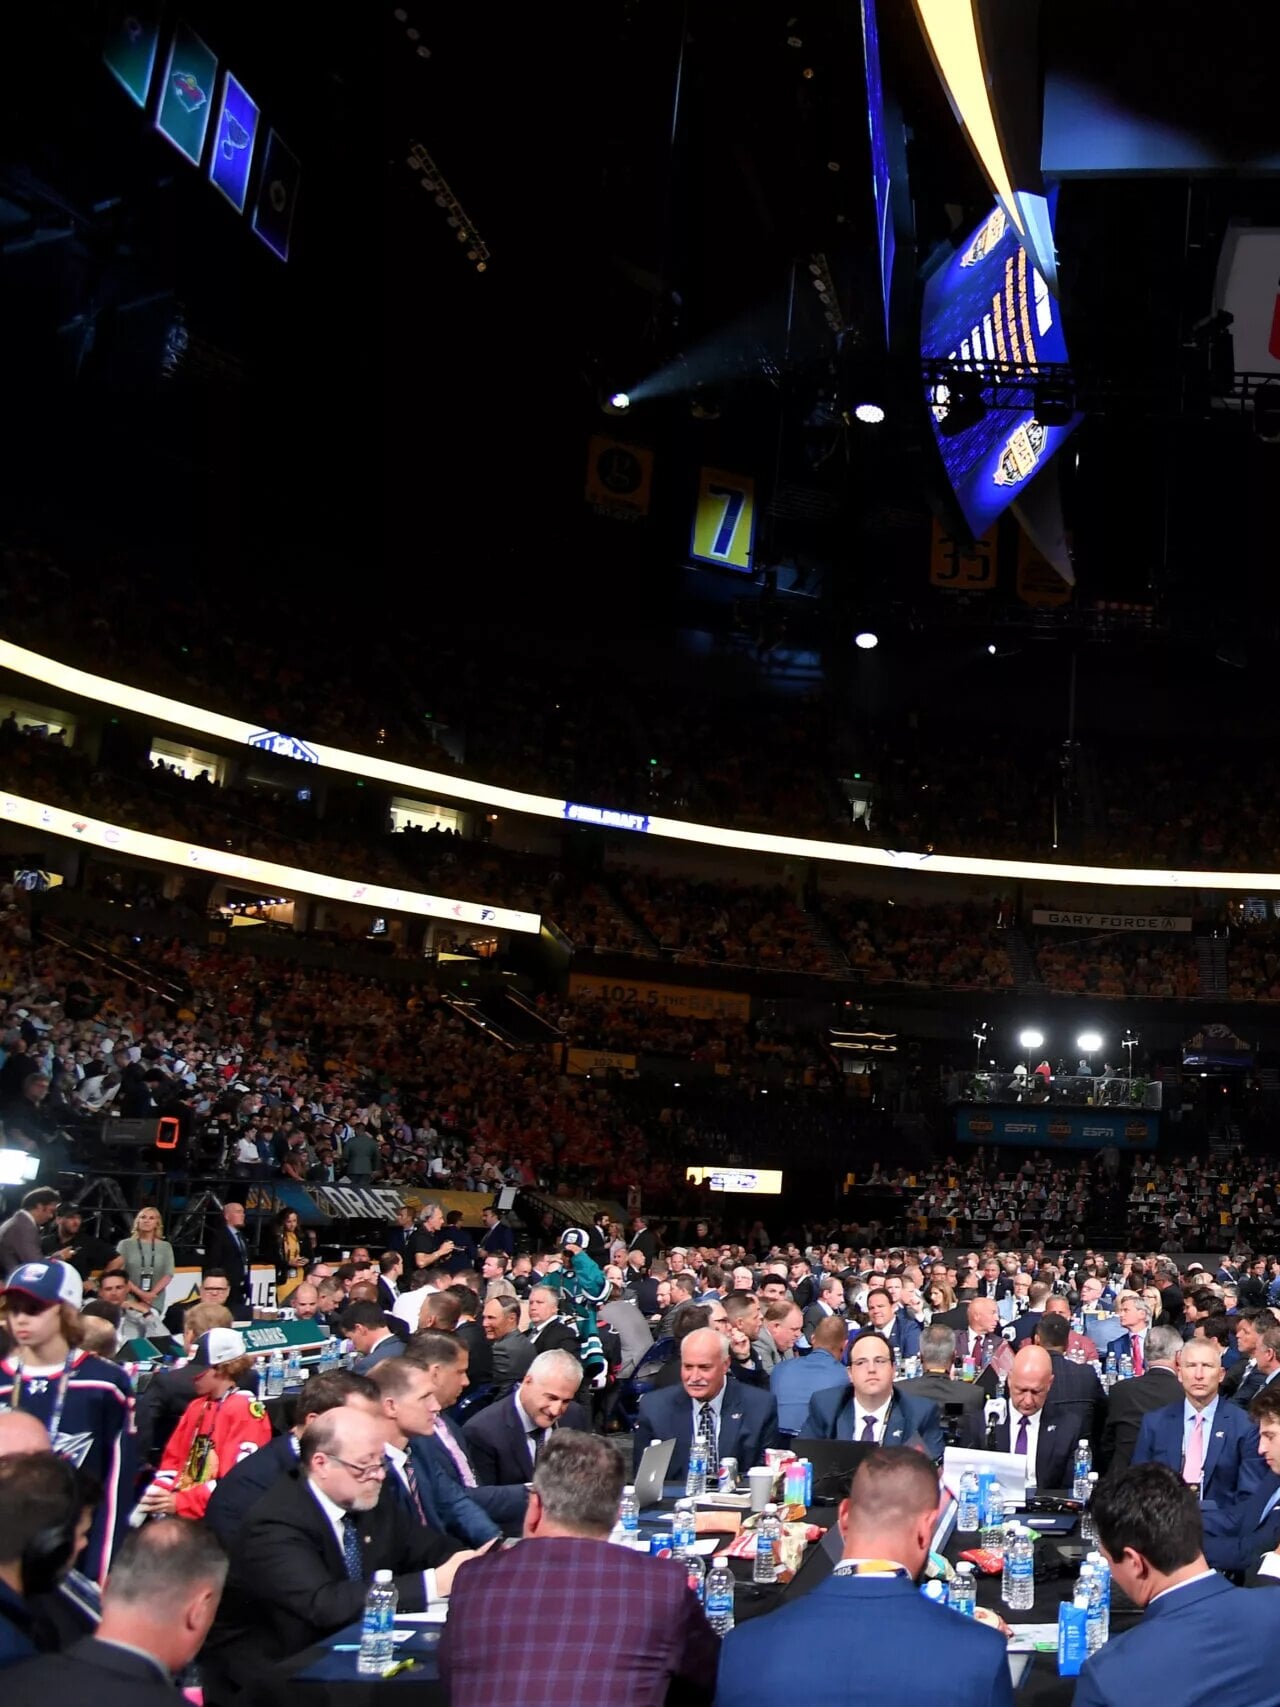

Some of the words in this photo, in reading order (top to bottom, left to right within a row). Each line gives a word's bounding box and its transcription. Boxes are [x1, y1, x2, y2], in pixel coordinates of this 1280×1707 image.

[709, 483, 745, 559] 7
[1048, 912, 1093, 925] GARY
[1100, 917, 1158, 928] FORCE
[600, 984, 660, 1006] 102.5
[1004, 1123, 1038, 1133] ESPN
[1083, 1127, 1114, 1137] ESPN
[321, 1186, 406, 1221] DRAFT
